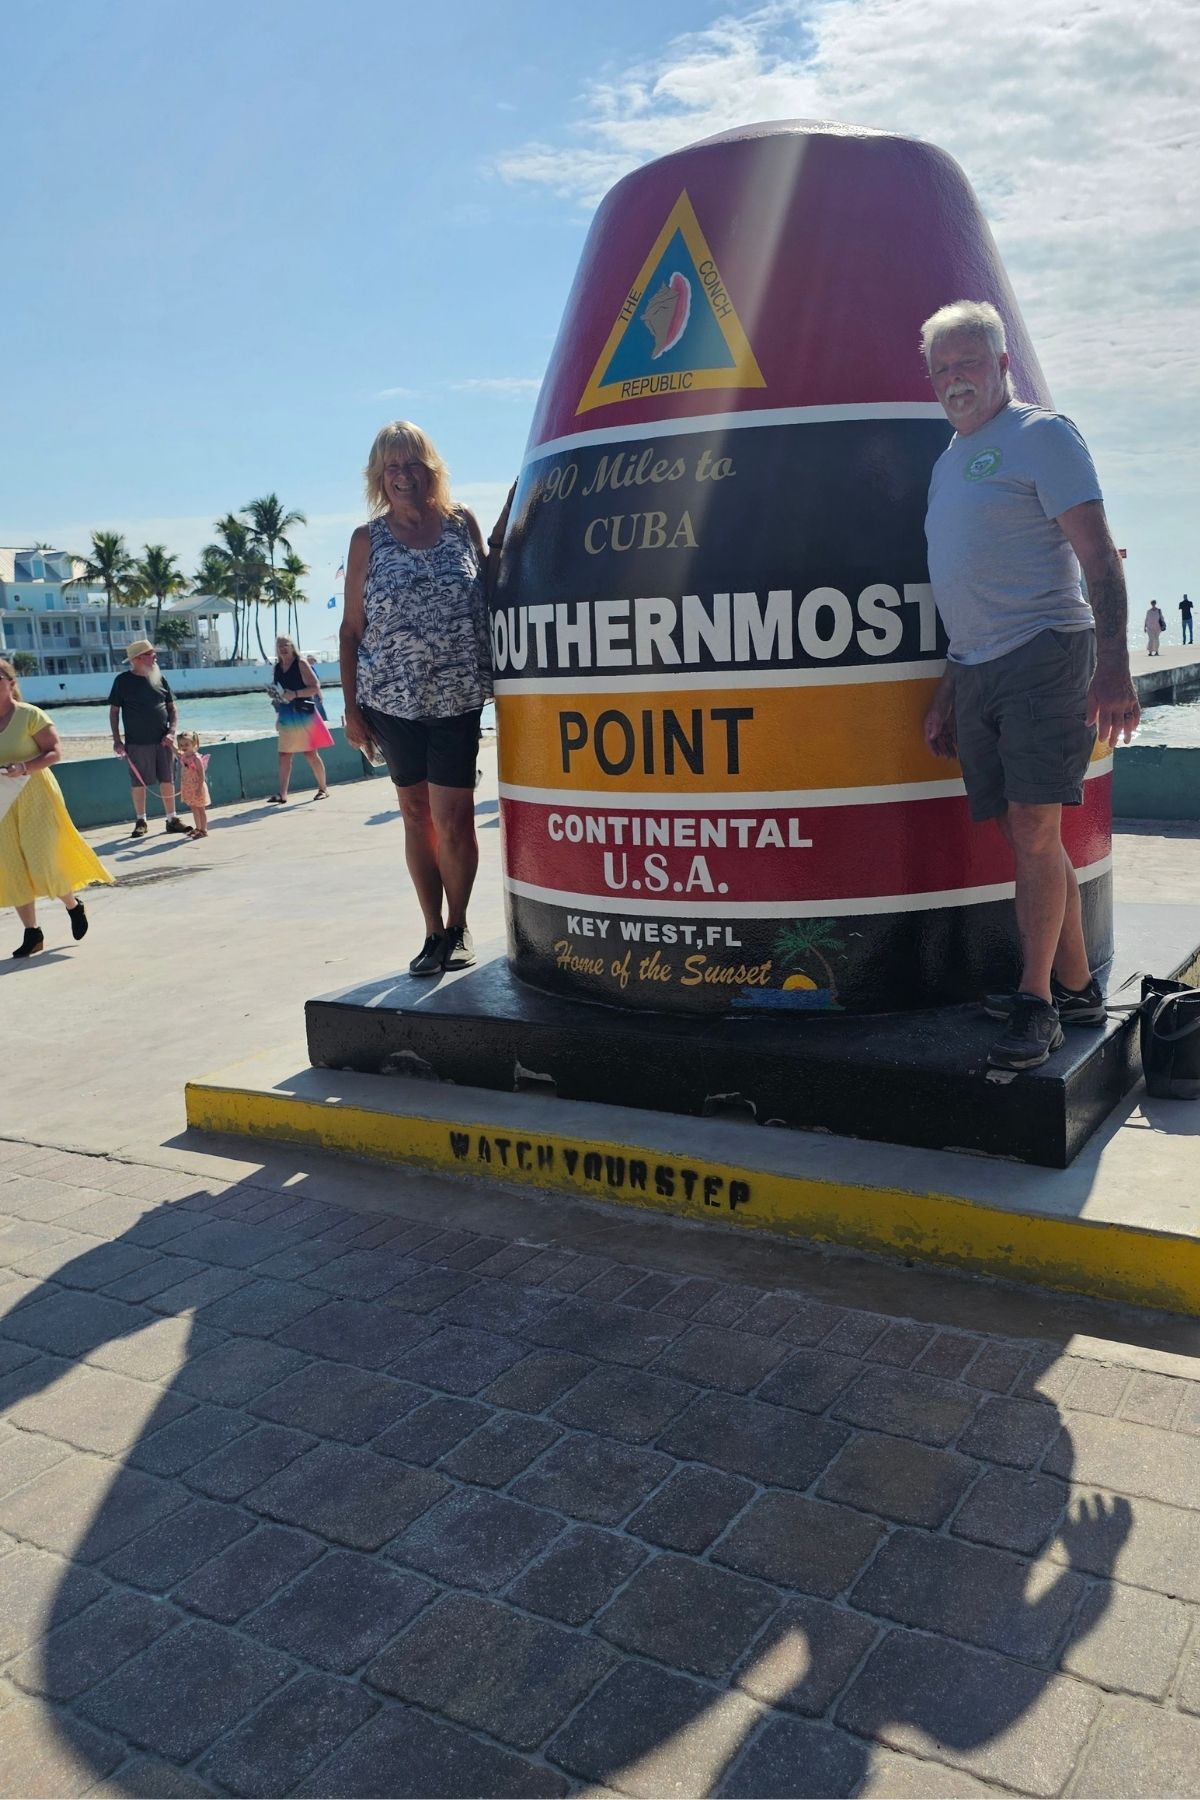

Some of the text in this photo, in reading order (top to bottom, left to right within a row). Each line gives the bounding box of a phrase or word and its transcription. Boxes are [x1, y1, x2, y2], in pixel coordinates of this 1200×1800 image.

[616, 288, 642, 323] THE
[698, 260, 732, 320] CONCH
[621, 372, 693, 398] REPUBLIC
[543, 448, 736, 503] 90 Miles to
[584, 510, 699, 554] CUBA
[558, 707, 754, 776] POINT
[548, 813, 813, 848] CONTINENTAL
[603, 852, 729, 894] U.S.A.
[567, 915, 611, 938] KEY
[554, 940, 772, 989] Home of the Sunset
[449, 1131, 751, 1210] WATCH YOUR STEP
